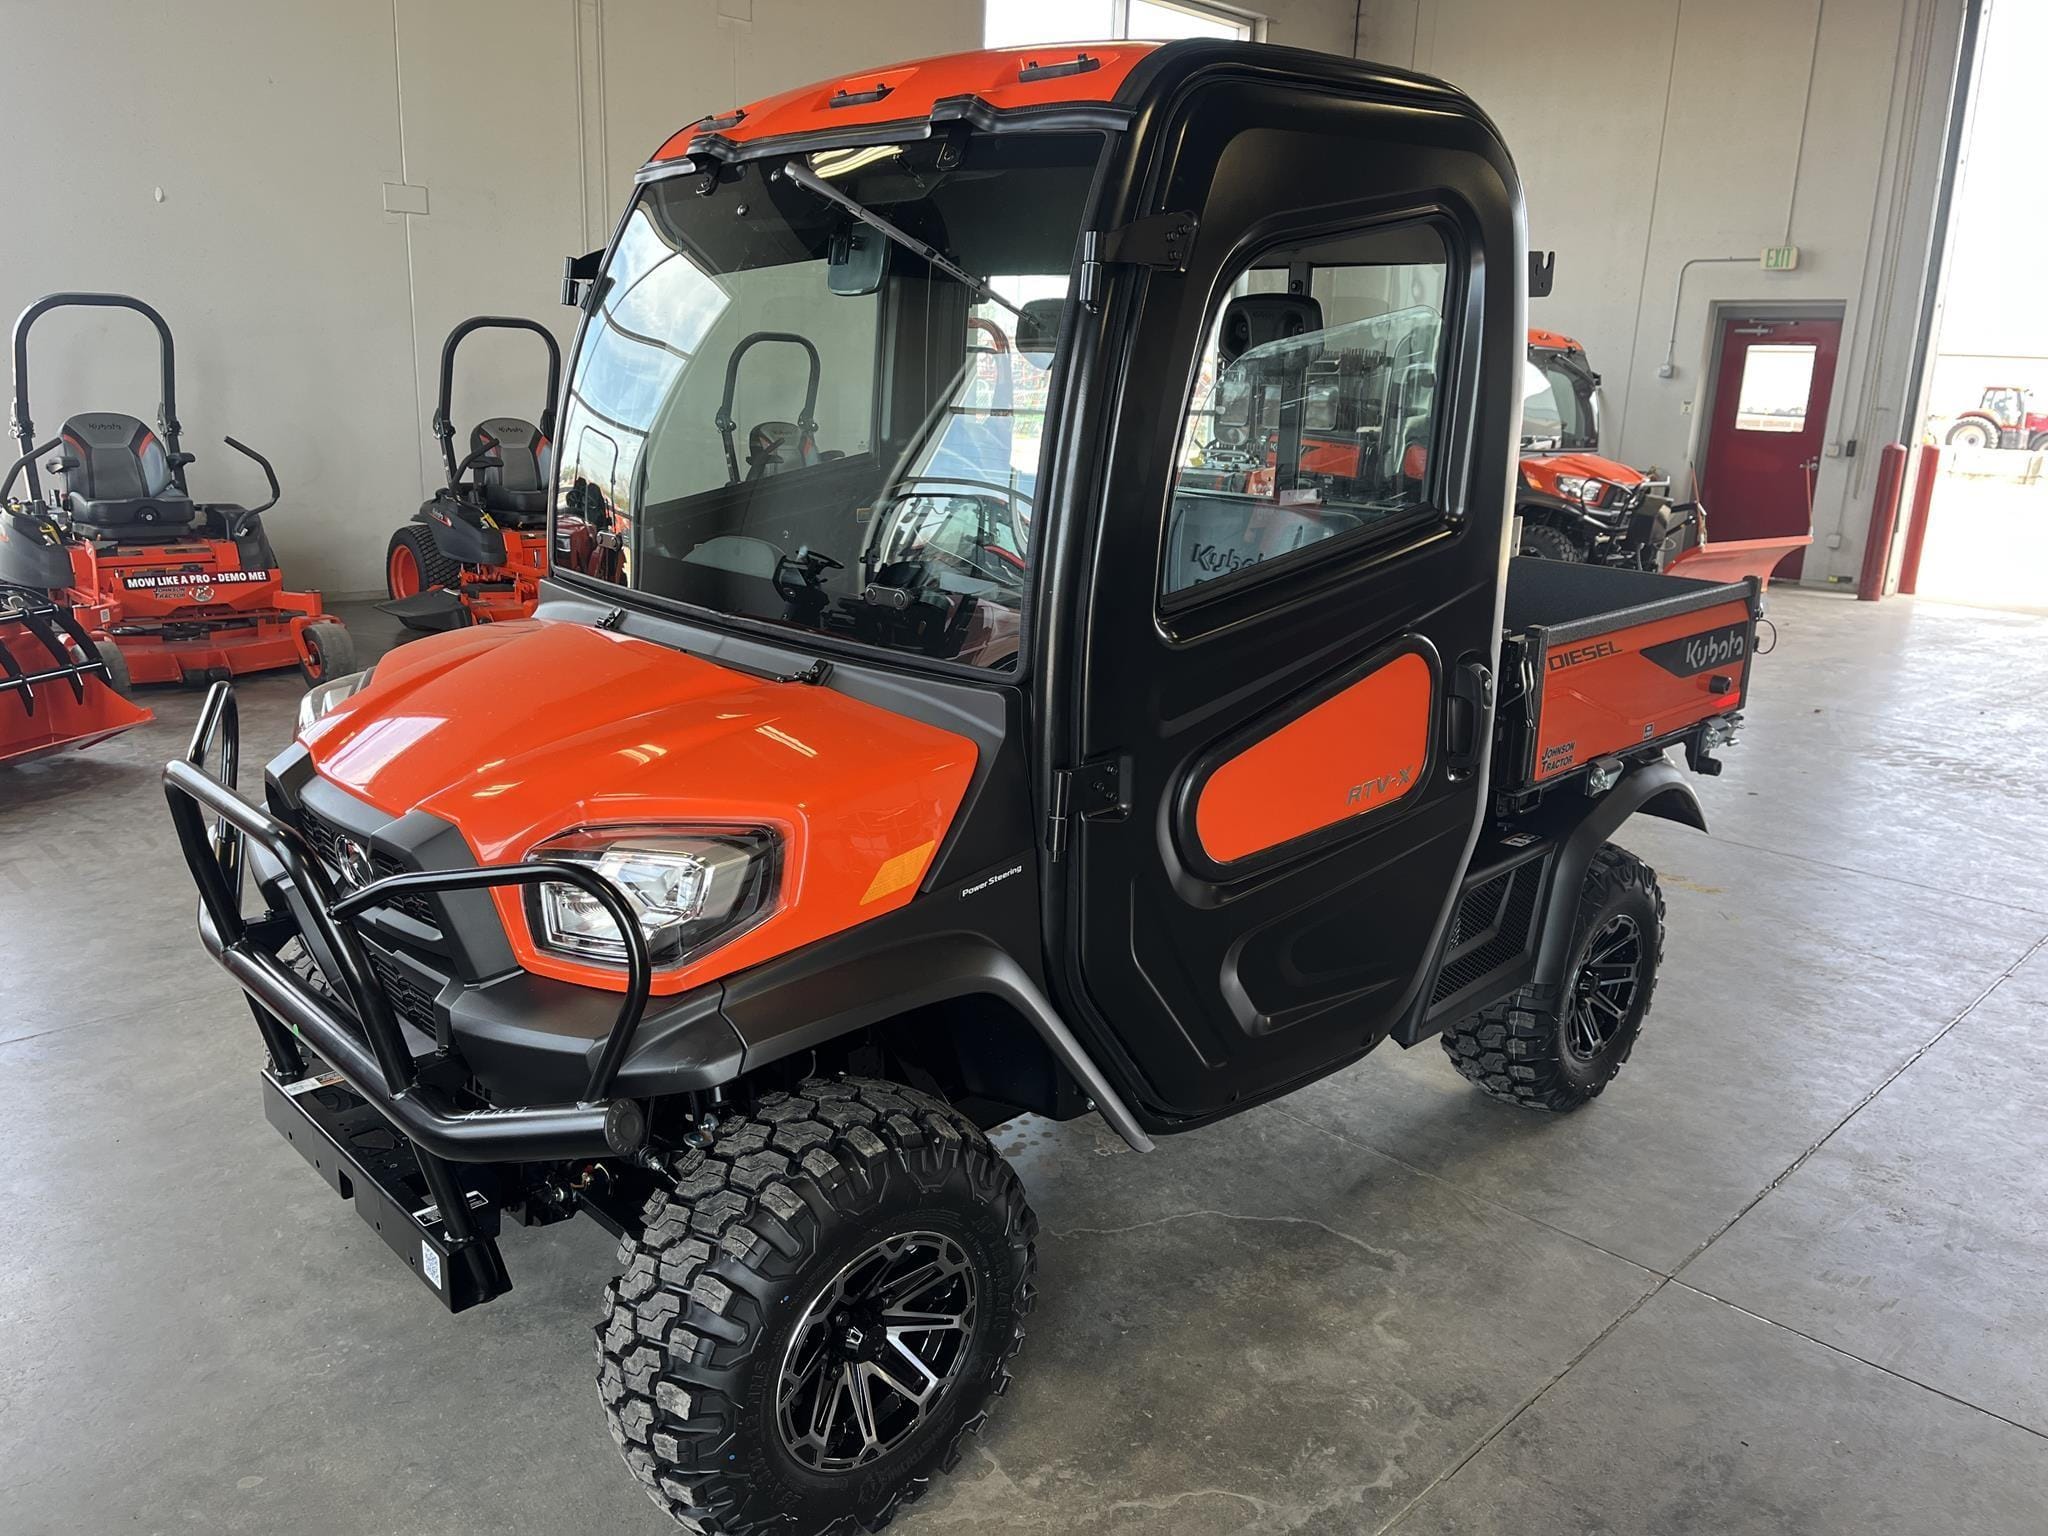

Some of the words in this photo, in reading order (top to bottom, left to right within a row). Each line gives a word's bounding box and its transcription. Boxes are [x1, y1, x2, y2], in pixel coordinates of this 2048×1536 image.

[1766, 248, 1792, 268] EXIT
[127, 577, 156, 588] MOW
[156, 575, 178, 586] LIKE
[180, 575, 188, 584] A
[190, 573, 210, 583] PRO
[217, 572, 246, 582] DEMO
[248, 571, 267, 580] ME!
[1548, 641, 1624, 671] DIESEL
[1686, 630, 1744, 668] Kubota
[1542, 741, 1575, 760] JOHNSON
[1542, 755, 1573, 773] TRACTOR
[1346, 764, 1413, 805] RTV-X
[962, 881, 988, 897] Power
[988, 865, 1022, 886] Steering
